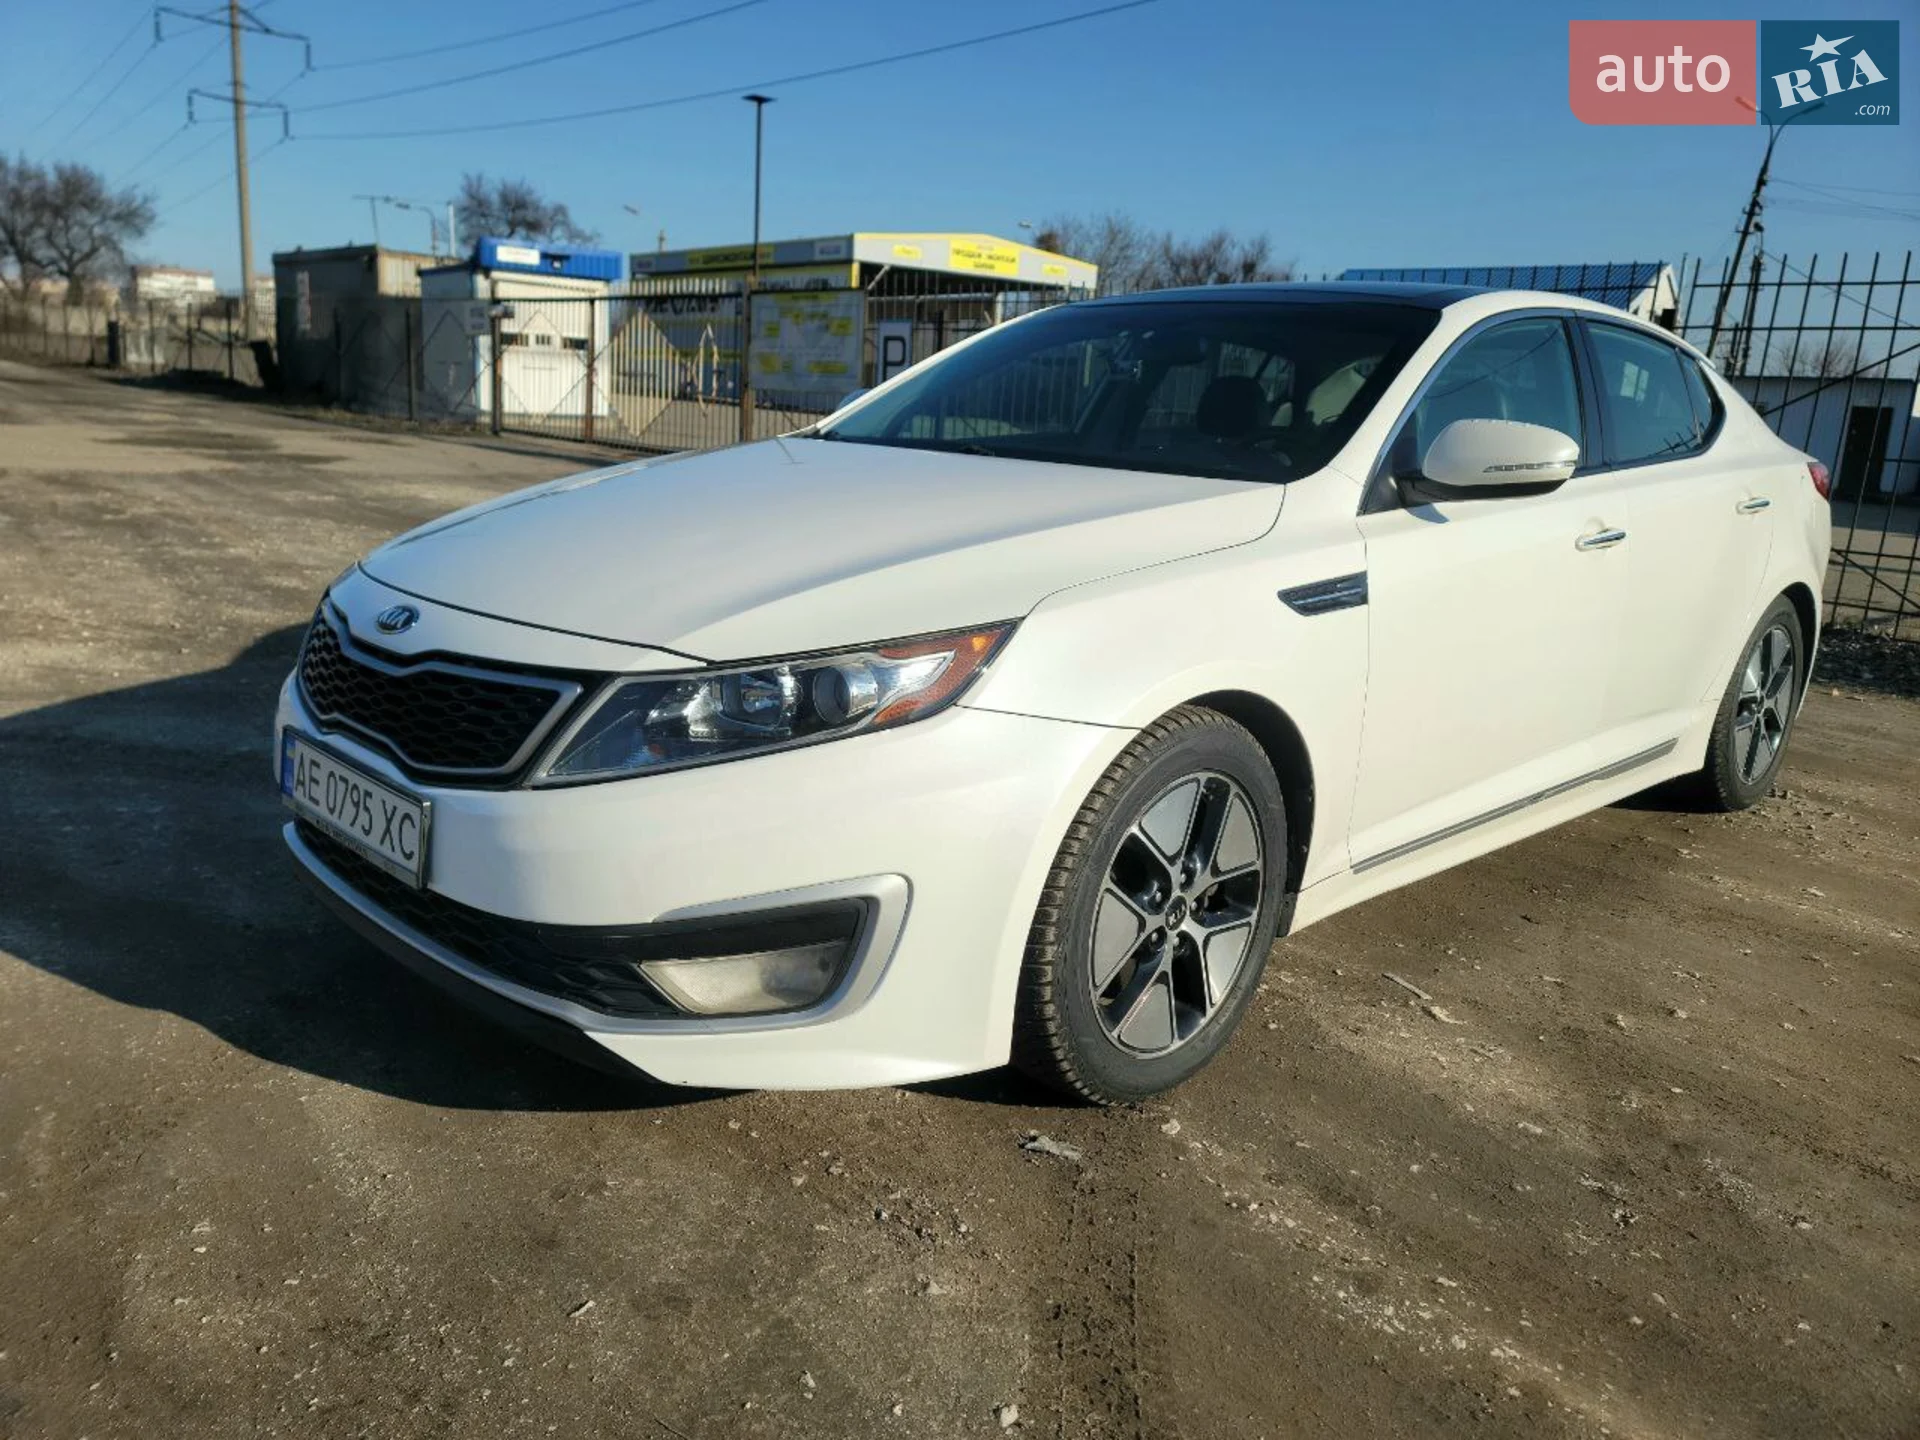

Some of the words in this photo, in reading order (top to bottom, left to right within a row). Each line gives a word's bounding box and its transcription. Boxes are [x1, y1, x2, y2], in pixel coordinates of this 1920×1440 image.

[882, 336, 907, 383] P
[295, 753, 321, 807] AE
[326, 770, 373, 837] 0795
[380, 799, 416, 861] XC
